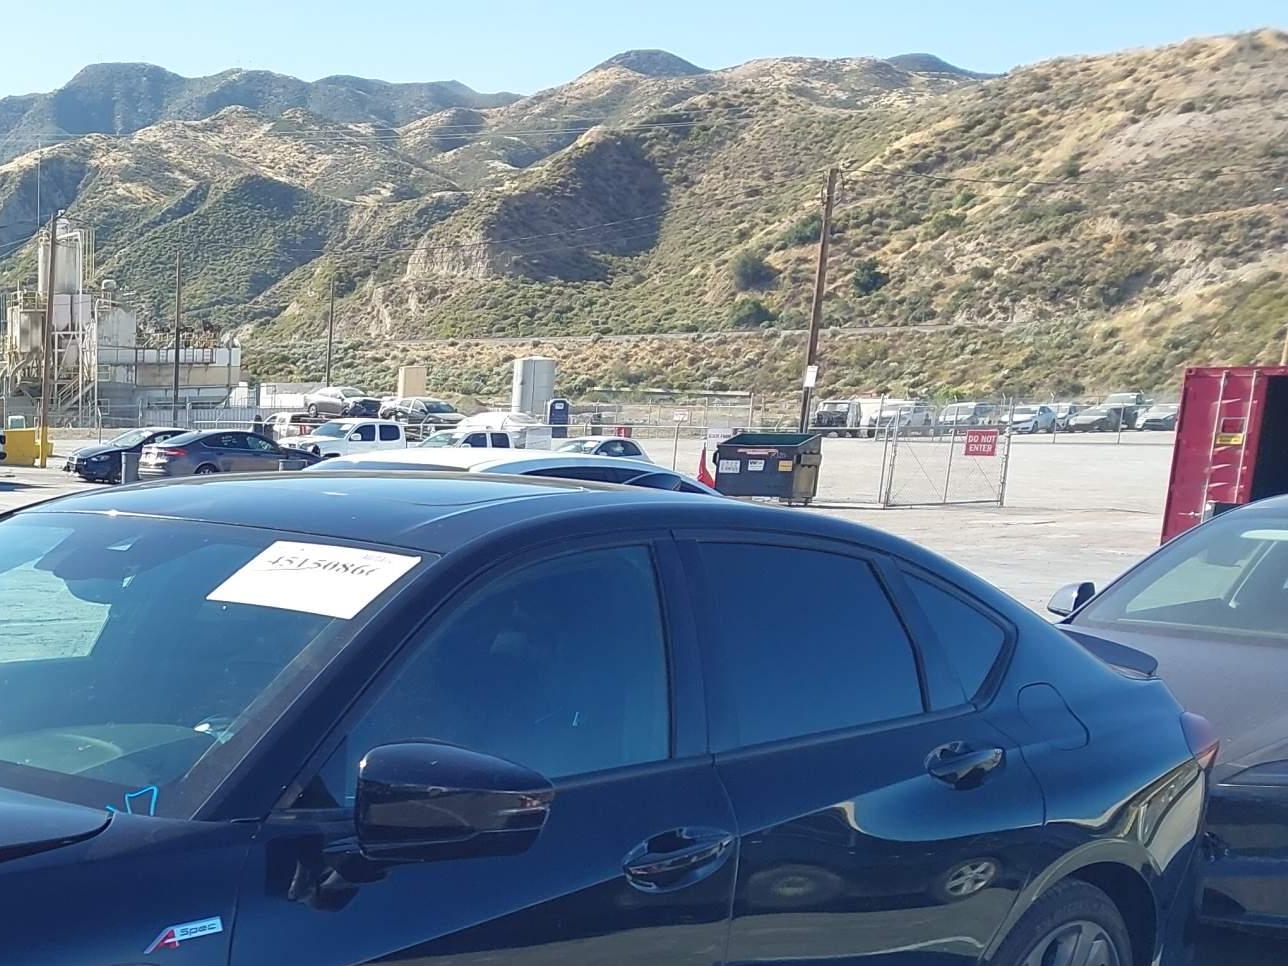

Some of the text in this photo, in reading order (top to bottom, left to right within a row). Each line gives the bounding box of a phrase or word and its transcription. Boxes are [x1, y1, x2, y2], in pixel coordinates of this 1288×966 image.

[968, 434, 997, 443] DO NOT
[969, 443, 993, 452] ENTER
